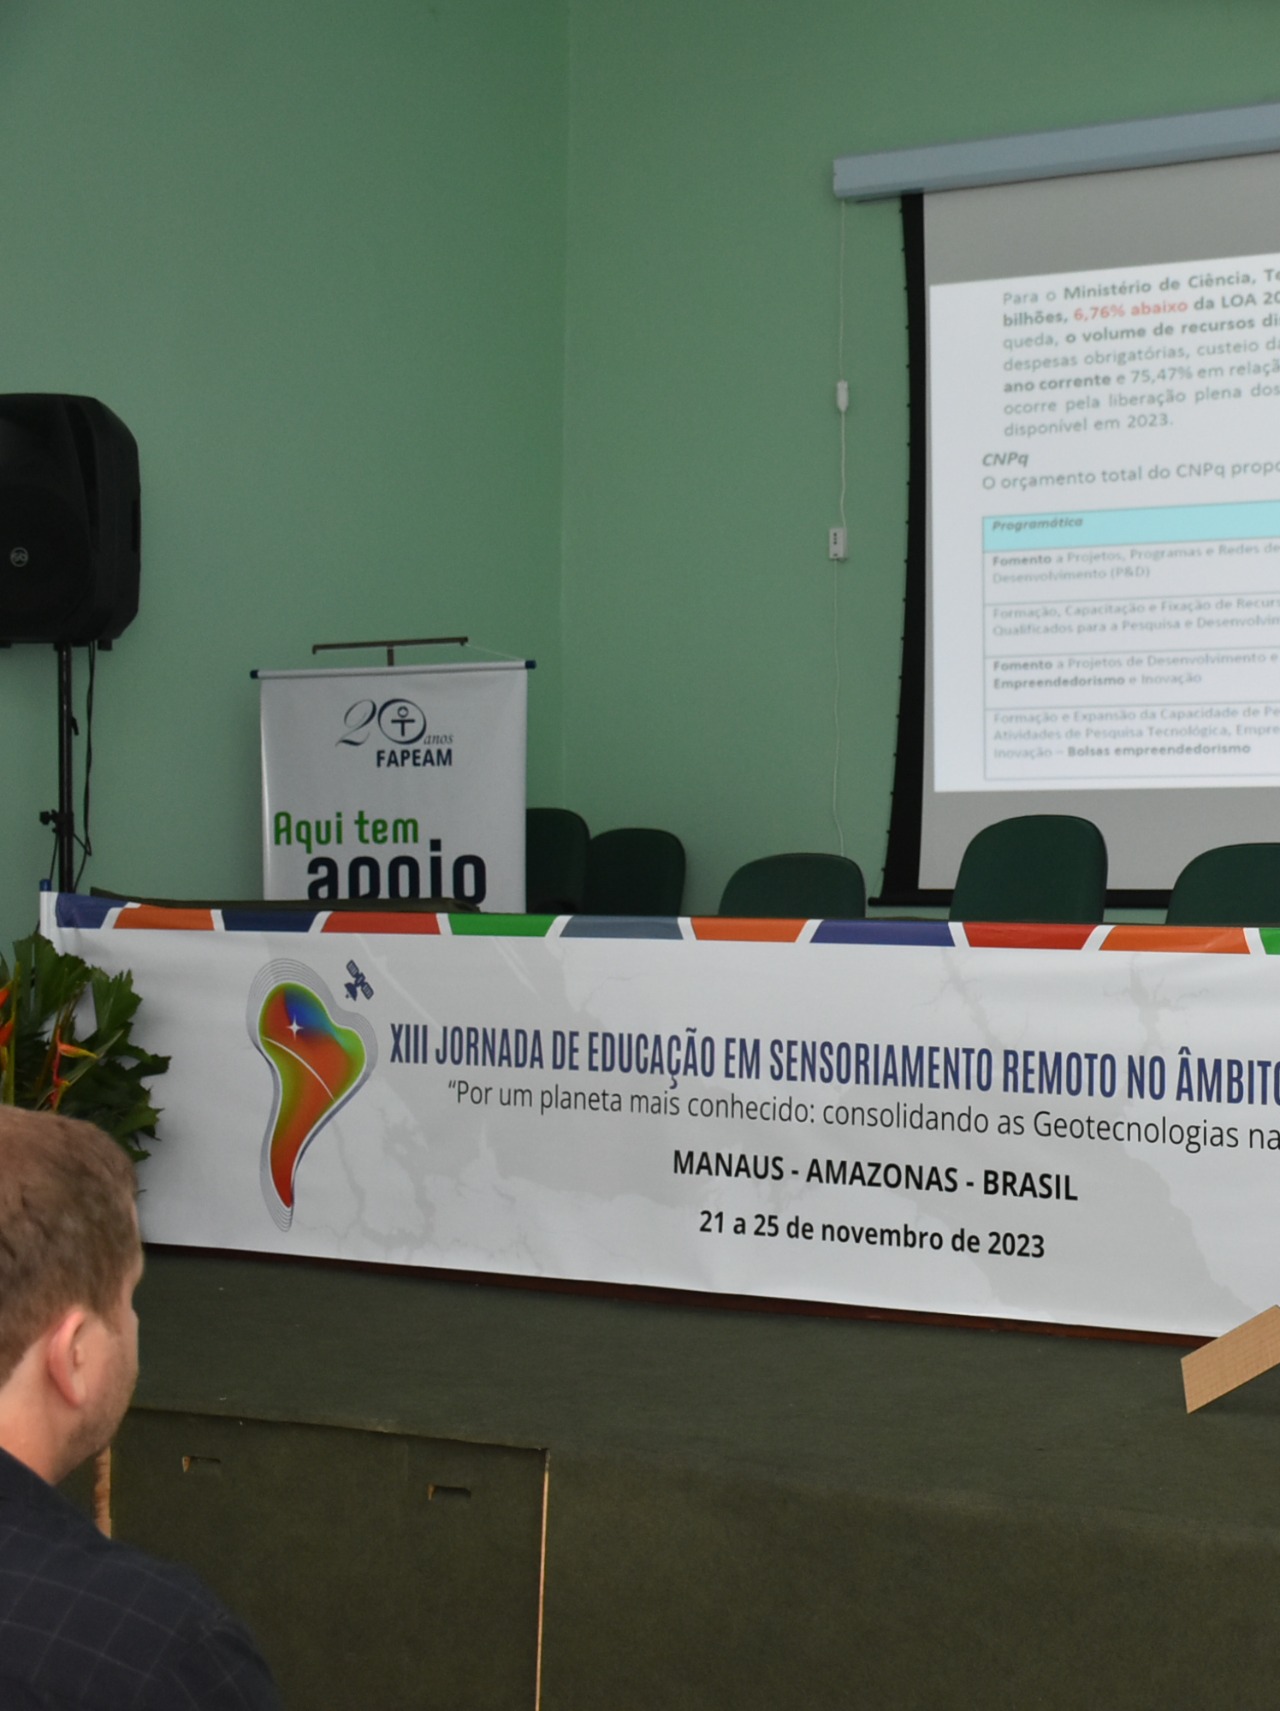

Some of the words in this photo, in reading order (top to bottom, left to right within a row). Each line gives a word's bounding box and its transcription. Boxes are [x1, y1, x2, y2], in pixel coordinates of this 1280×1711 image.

[1002, 289, 1040, 305] Para
[1045, 289, 1057, 301] o
[1062, 277, 1153, 300] Ministério
[1158, 275, 1182, 292] de
[1187, 269, 1257, 289] Ciência,
[1002, 308, 1069, 327] bilhões,
[1073, 301, 1126, 323] 6,76%
[1130, 297, 1189, 316] abaixo
[1192, 294, 1216, 311] da
[1220, 290, 1258, 308] LOA
[1002, 331, 1059, 354] queda,
[1064, 332, 1078, 344] o
[1081, 325, 1148, 343] volume
[1151, 320, 1176, 337] de
[1180, 317, 1257, 335] recursos
[1002, 353, 1079, 373] despesas
[1083, 342, 1191, 367] obrigatórias,
[1196, 336, 1260, 356] custeio
[1003, 413, 1089, 439] disponível
[1092, 418, 1121, 431] em
[1126, 411, 1174, 429] 2023.
[981, 449, 1030, 469] CNPq
[981, 473, 997, 490] O
[1000, 469, 1097, 492] orçamento
[1100, 465, 1144, 483] total
[1146, 464, 1172, 480] do
[1175, 461, 1227, 481] CNPq
[990, 515, 1085, 534] Programática
[376, 748, 453, 768] FAPEAM
[423, 733, 454, 746] anos
[274, 811, 343, 854] Aqui
[354, 810, 419, 845] tem
[390, 1023, 429, 1065] XIII
[434, 1025, 545, 1070] JORNADA
[552, 1030, 580, 1072] DE
[588, 1027, 715, 1089] EDUCAÇÃO
[724, 1037, 761, 1080] EM
[769, 1040, 993, 1092] SENSORIAMENTO
[1002, 1050, 1117, 1098] REMOTO
[1127, 1054, 1166, 1101] NO
[498, 1088, 533, 1107] um
[540, 1081, 624, 1115] planeta
[629, 1089, 681, 1115] mais
[688, 1089, 815, 1124] conhecido:
[823, 1096, 989, 1133] consolidando
[997, 1113, 1025, 1136] as
[1033, 1111, 1240, 1154] Geotecnologias
[674, 1149, 784, 1181] MANAUS
[806, 1158, 958, 1193] AMAZONAS
[984, 1169, 1078, 1201] BRASIL
[700, 1210, 723, 1234] 21
[733, 1217, 746, 1235] a
[754, 1213, 779, 1238] 25
[786, 1215, 814, 1240] de
[822, 1223, 943, 1251] novembro
[951, 1228, 980, 1254] de
[988, 1231, 1044, 1259] 2023
